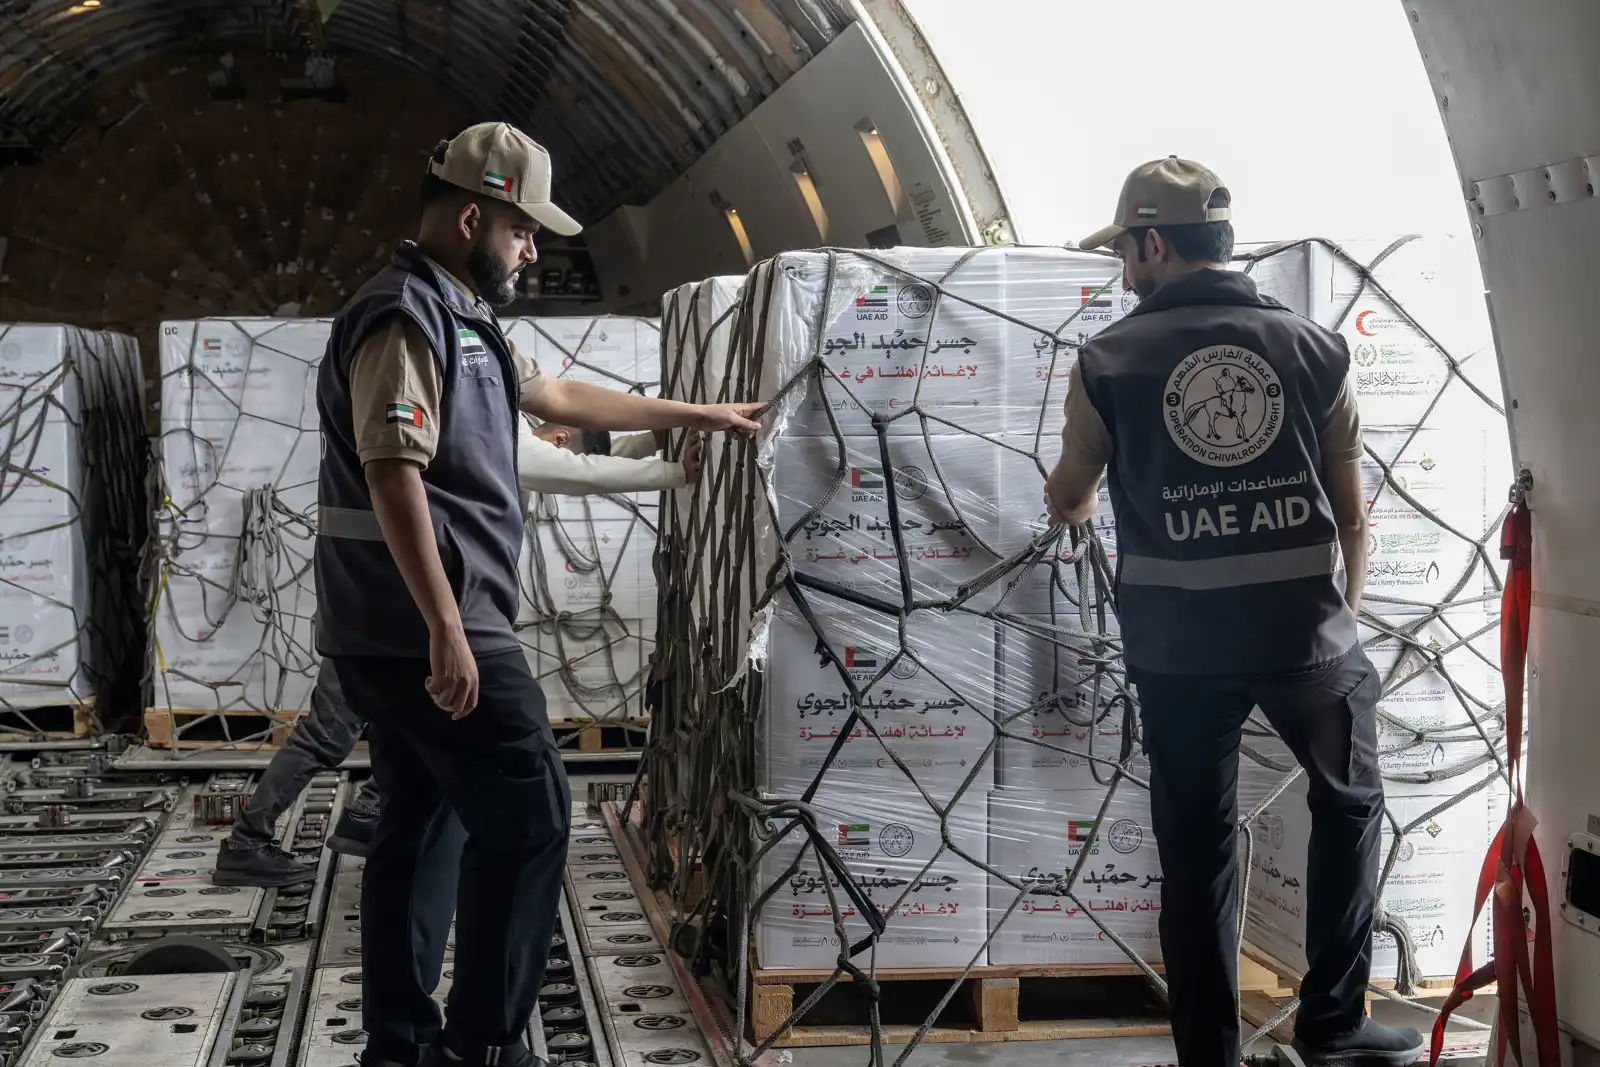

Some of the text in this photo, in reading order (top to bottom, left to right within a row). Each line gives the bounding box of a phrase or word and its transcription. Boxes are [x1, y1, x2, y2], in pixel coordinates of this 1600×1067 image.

[857, 313, 888, 321] UAE AID
[823, 331, 865, 356] الجو
[929, 336, 978, 355] جسر
[1203, 348, 1244, 363] الفارس
[855, 366, 874, 384] في
[878, 364, 918, 378] أهلنا
[1173, 354, 1200, 392] الشهم
[1243, 353, 1271, 383] عملية
[1169, 410, 1208, 457] OPERATION
[1208, 436, 1268, 462] CHIVALROUS
[1264, 401, 1281, 439] KNIGHT
[1162, 470, 1308, 502] المساعدات الإماراتية
[852, 495, 869, 503] UAE
[803, 512, 861, 541] الجوي
[1165, 496, 1310, 541] UAE AID
[806, 547, 846, 563] غزة
[850, 547, 869, 564] في
[797, 692, 854, 719] الجوي
[917, 697, 966, 716] جسر
[800, 726, 839, 741] غزة
[909, 724, 966, 740] لإغاثة
[1032, 725, 1072, 739] غزة
[911, 875, 959, 893] جسر
[1137, 873, 1164, 888] سر
[792, 903, 833, 919] غزة
[902, 902, 959, 917] لإغاثة
[1022, 900, 1062, 915] غزة
[1088, 897, 1128, 912] أهلنا
